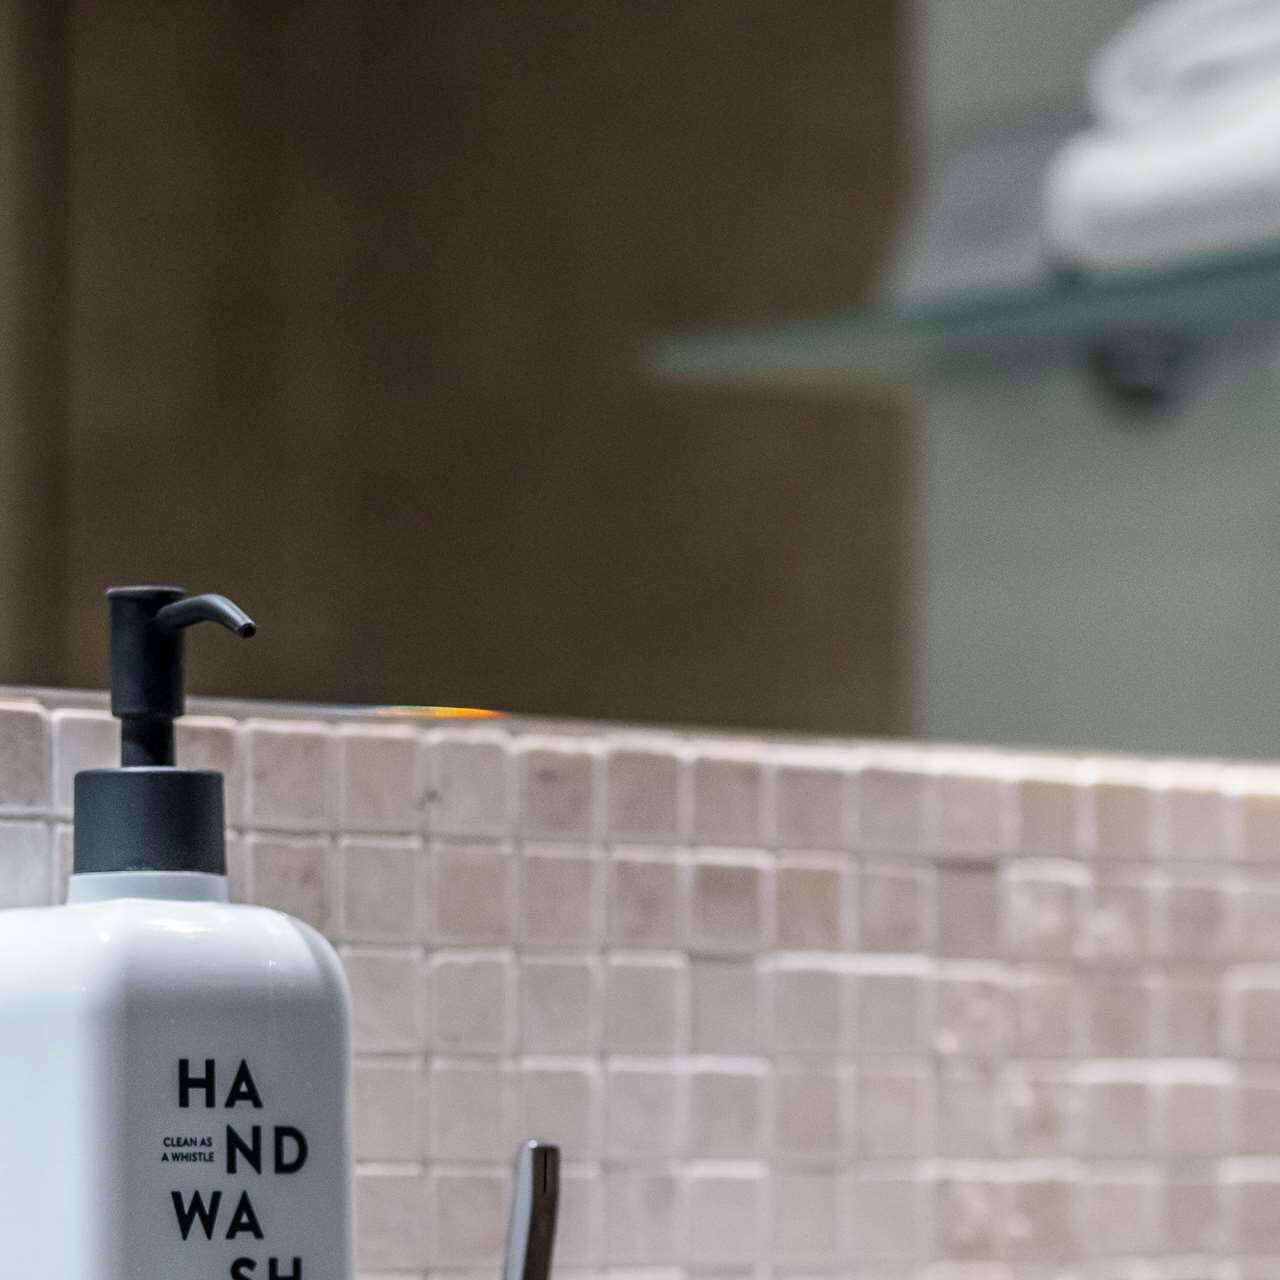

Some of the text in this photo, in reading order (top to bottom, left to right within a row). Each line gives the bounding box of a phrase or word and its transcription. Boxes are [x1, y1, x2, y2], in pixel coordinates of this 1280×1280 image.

[163, 1136, 213, 1147] CLEAN AS
[161, 1152, 215, 1162] A WHISTLE
